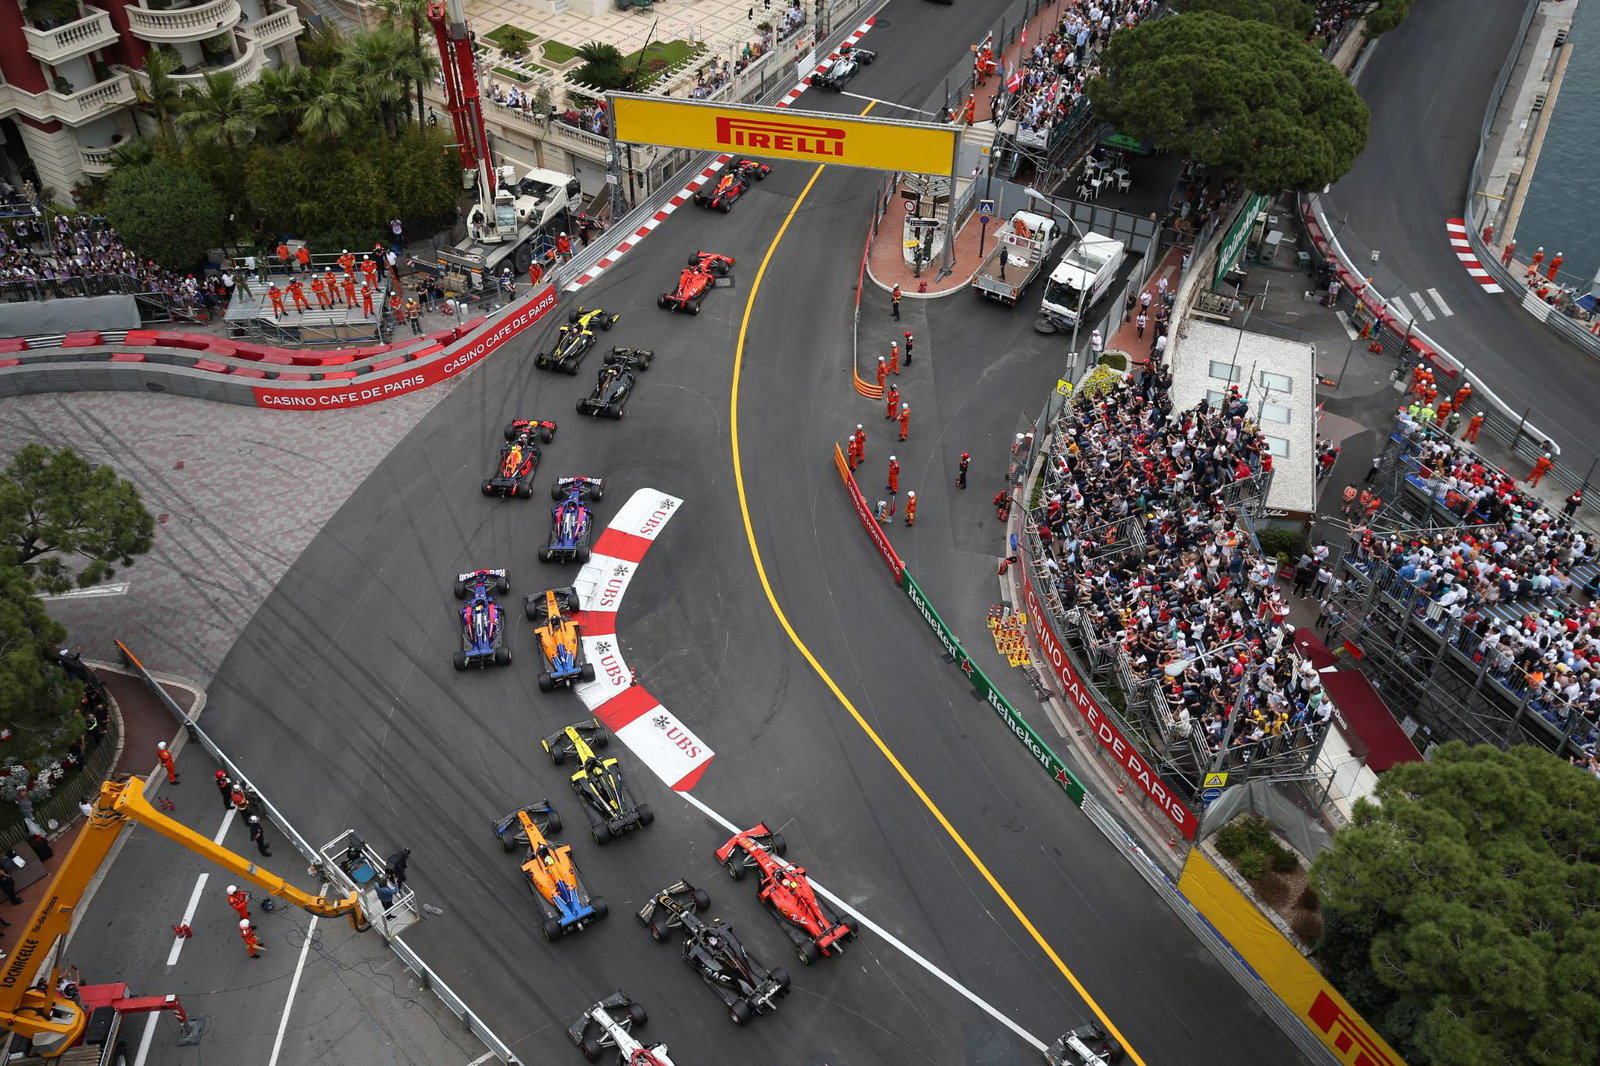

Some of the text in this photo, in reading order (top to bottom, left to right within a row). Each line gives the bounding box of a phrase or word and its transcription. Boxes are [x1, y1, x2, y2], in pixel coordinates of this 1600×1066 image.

[716, 117, 847, 156] PIRELLI
[445, 294, 555, 373] CASINO CAFE DE PARIS
[262, 374, 425, 406] CASINO CAFE DE PARIS
[640, 510, 667, 536] UBS
[600, 577, 623, 608] UBS
[908, 584, 956, 659] Heineken
[601, 654, 627, 686] UBS
[1028, 591, 1185, 825] CASINO CAFE DE PARIS
[665, 726, 702, 760] UBS
[988, 688, 1050, 768] Heineken
